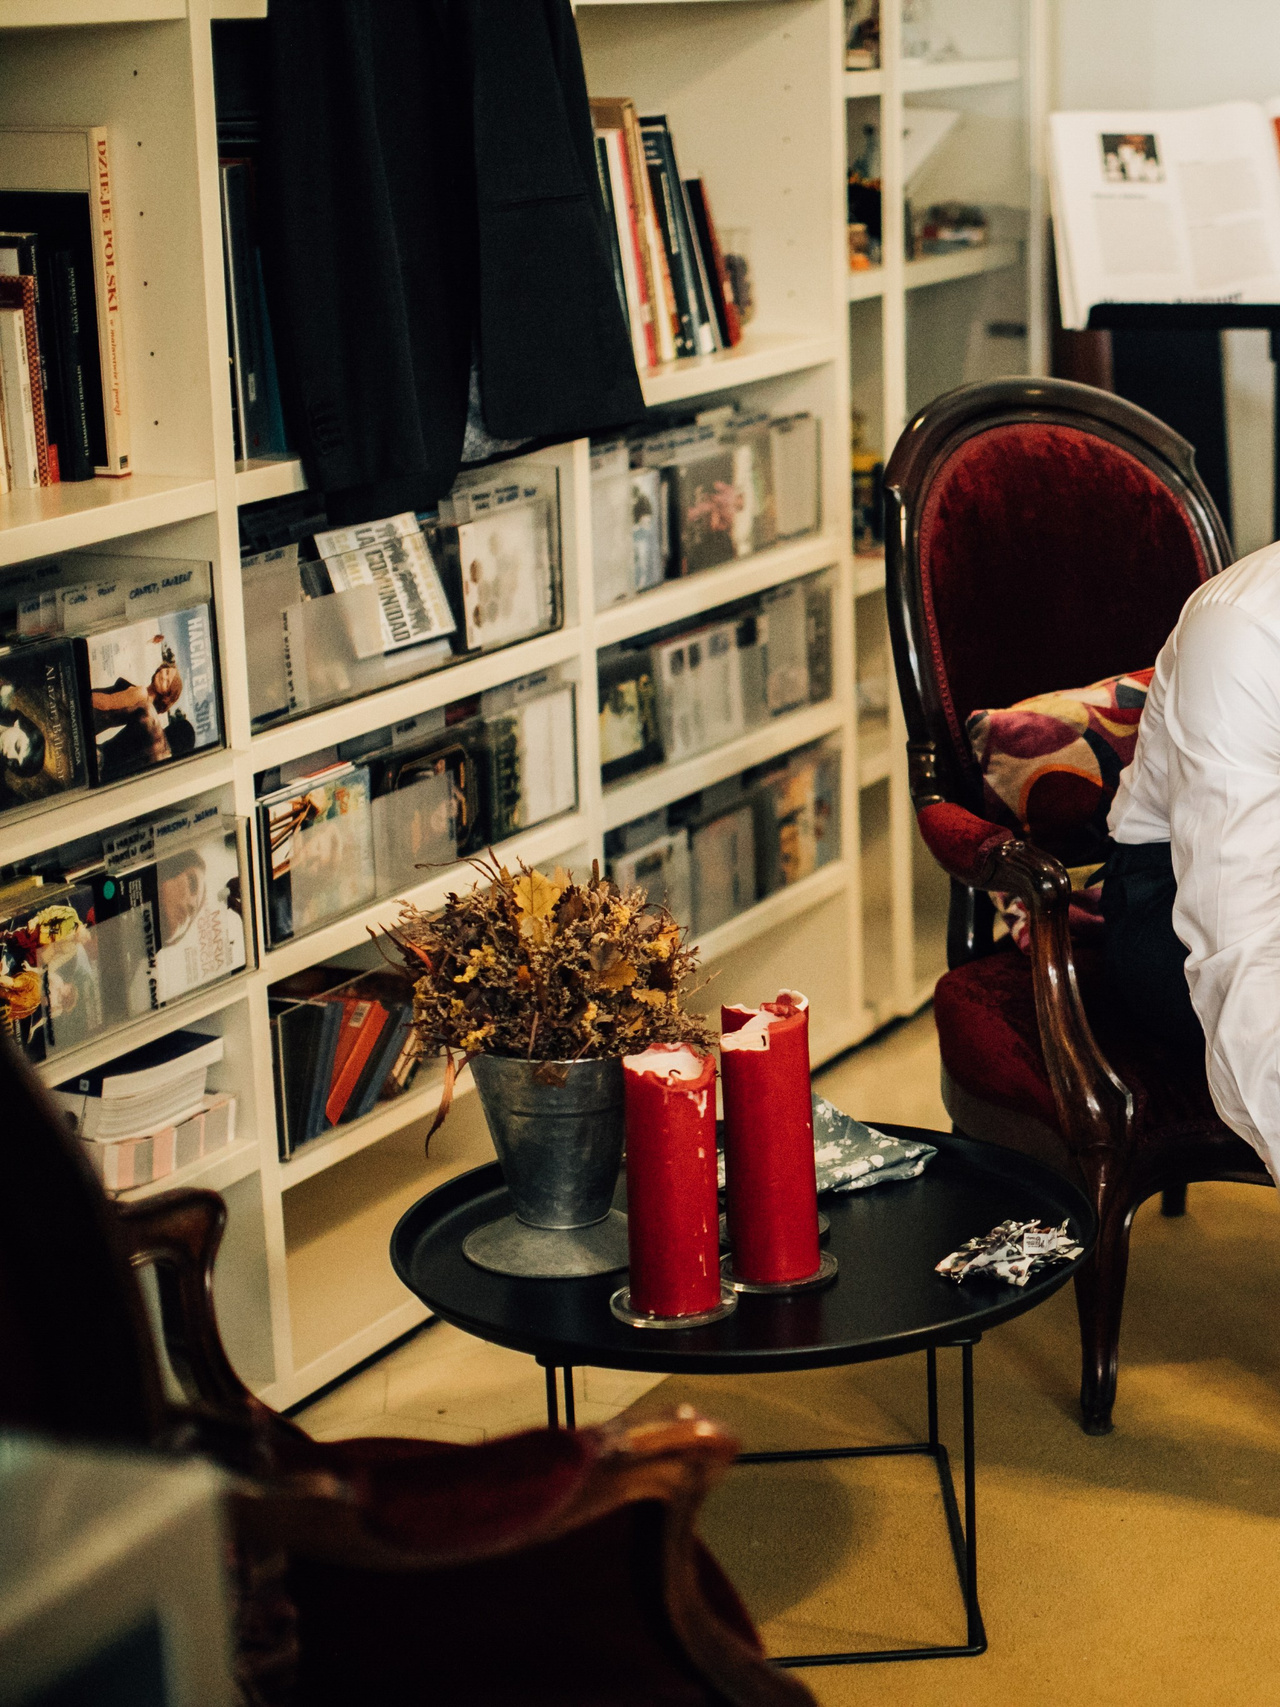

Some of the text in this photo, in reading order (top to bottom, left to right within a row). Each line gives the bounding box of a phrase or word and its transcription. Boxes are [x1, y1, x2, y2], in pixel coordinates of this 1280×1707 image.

[96, 139, 112, 224] DZIEJE
[103, 230, 119, 313] POLSKI
[355, 527, 411, 643] LA COMUNIDAD
[187, 617, 211, 736] HACIA EL SUR
